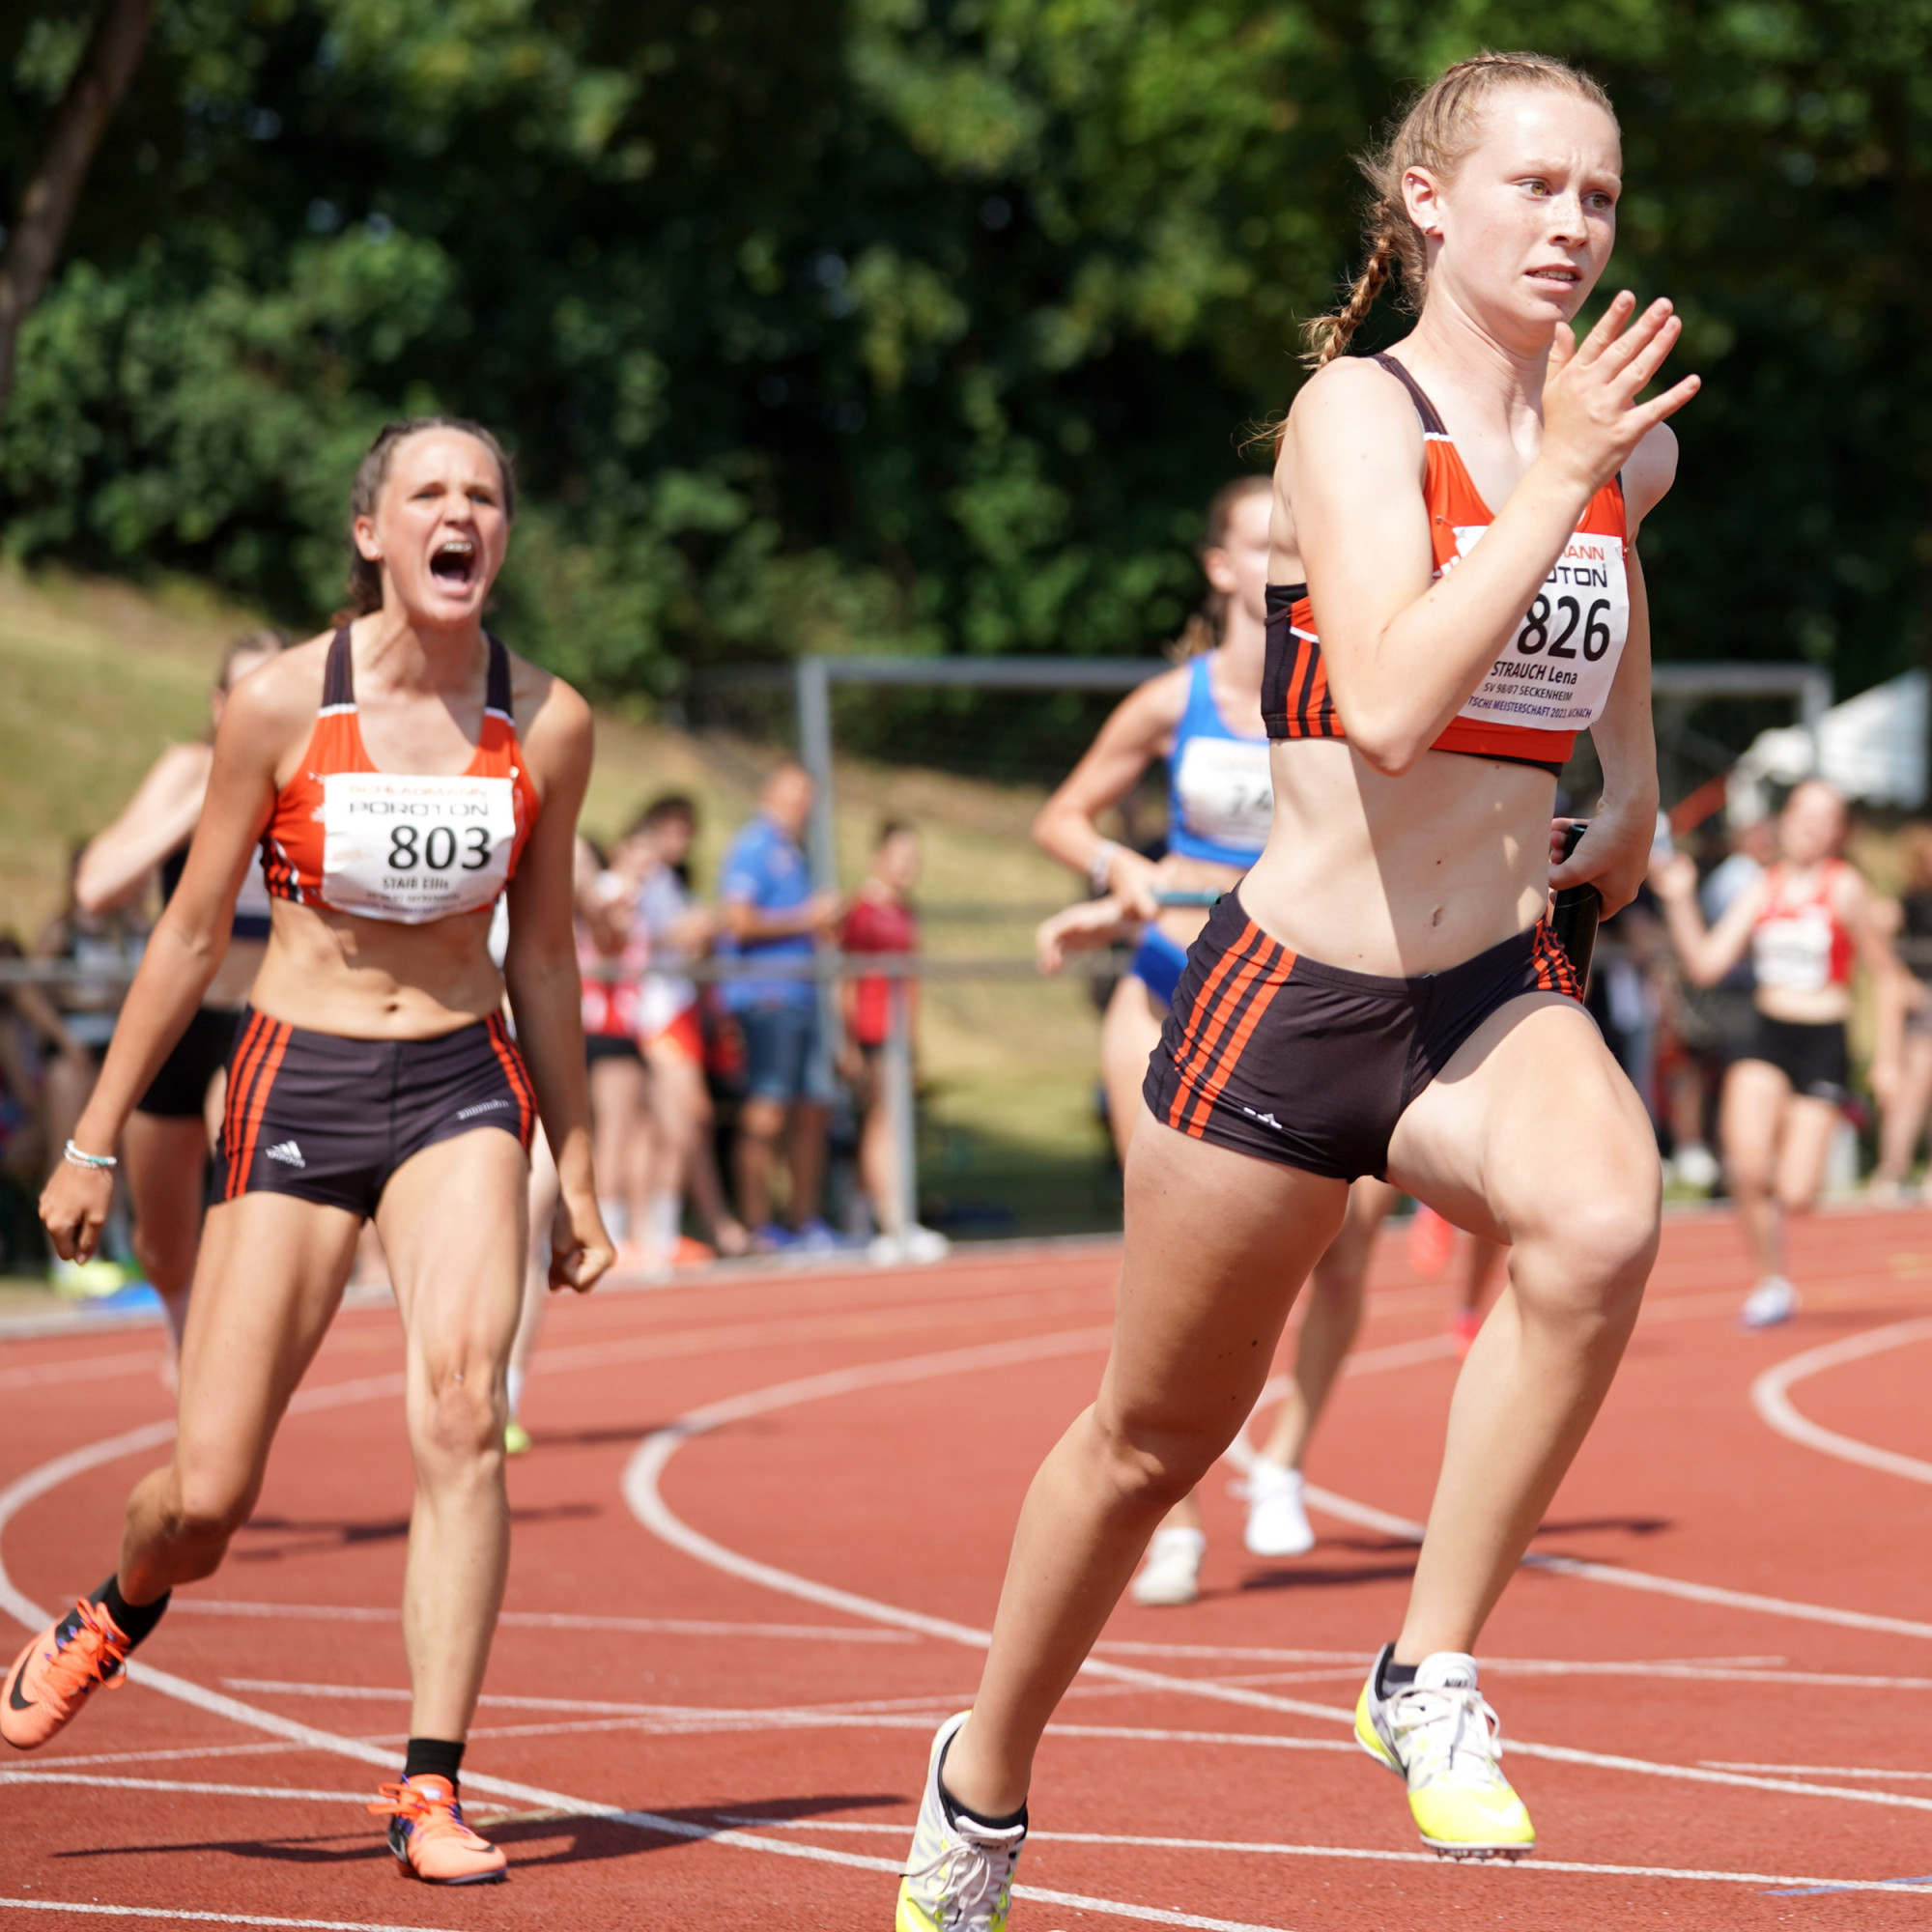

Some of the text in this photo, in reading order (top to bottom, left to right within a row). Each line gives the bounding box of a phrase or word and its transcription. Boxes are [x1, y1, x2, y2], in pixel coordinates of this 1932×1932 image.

[1517, 593, 1610, 663] 826
[1491, 661, 1578, 685] STRAUCH Lena
[1484, 682, 1574, 702] SV 98/07 SECKENHEIM
[1467, 696, 1493, 710] TSCHE
[1493, 699, 1550, 717] MEISTERSCHAFT
[349, 801, 490, 817] POROTON
[387, 825, 493, 871] 803
